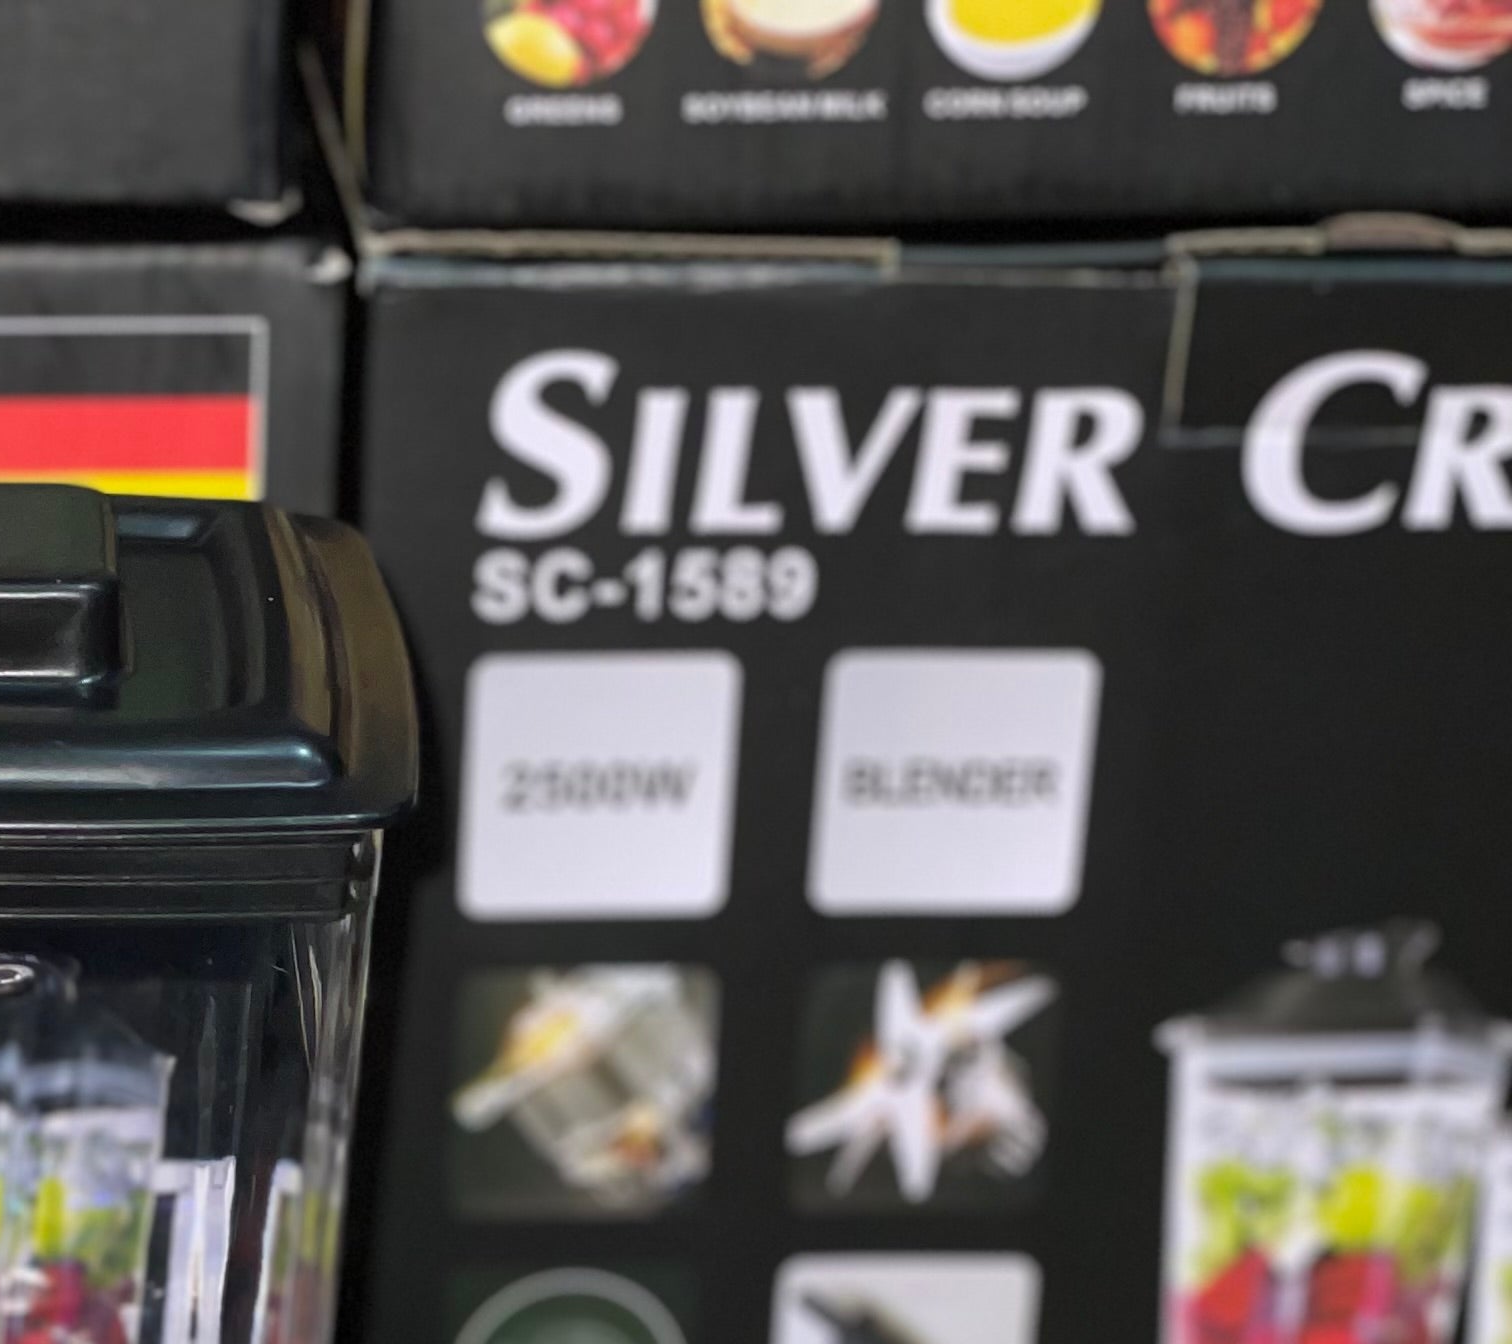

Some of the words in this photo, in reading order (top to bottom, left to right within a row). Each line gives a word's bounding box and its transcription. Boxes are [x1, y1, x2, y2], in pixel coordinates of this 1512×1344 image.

[1173, 81, 1278, 115] FRUITS
[476, 348, 1144, 540] SILVER
[471, 546, 818, 624] SC-1589
[842, 755, 1063, 804] BLENDER
